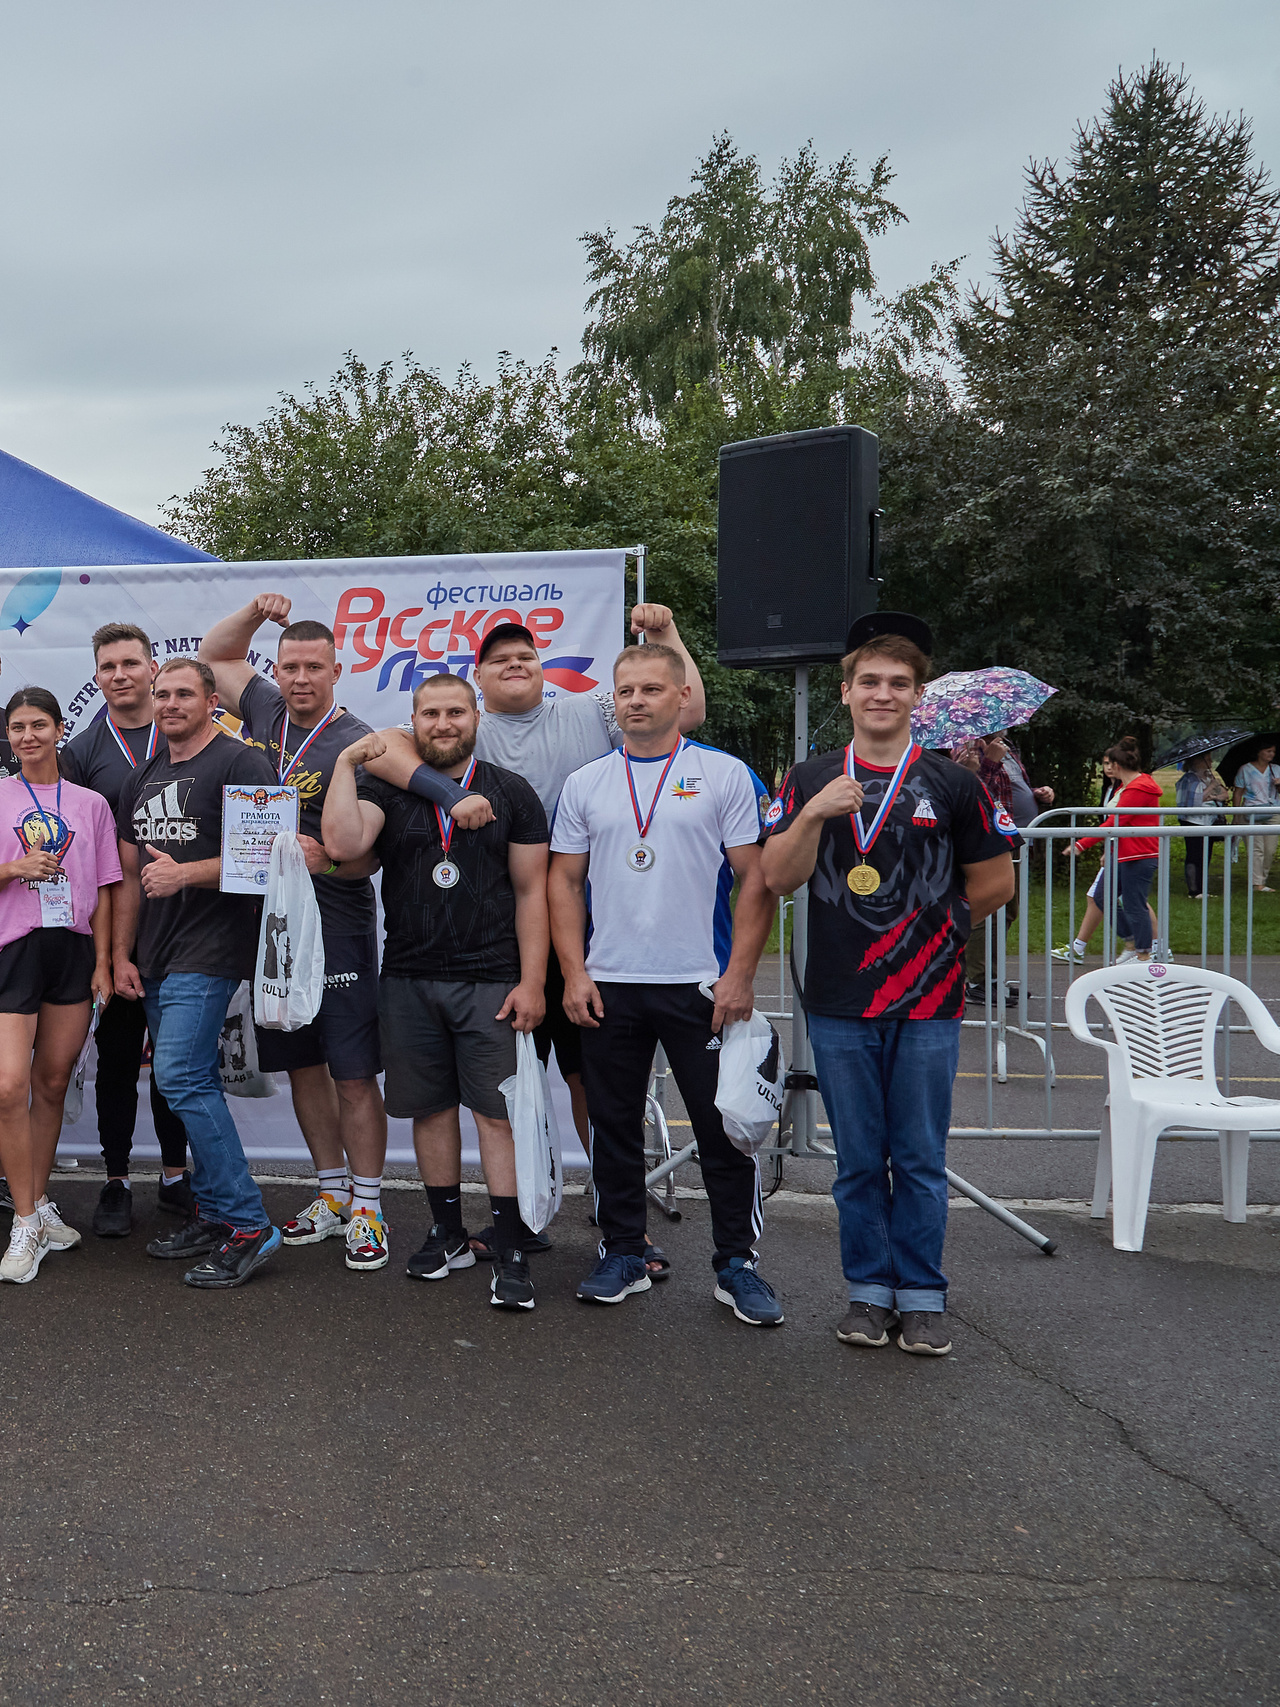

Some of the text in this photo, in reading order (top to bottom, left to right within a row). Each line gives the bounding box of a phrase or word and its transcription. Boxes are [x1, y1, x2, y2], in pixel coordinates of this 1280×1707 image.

[426, 581, 564, 611] фестиваль
[241, 812, 281, 820] ГРАМОТА
[251, 837, 257, 846] 2
[1149, 966, 1166, 974] 376
